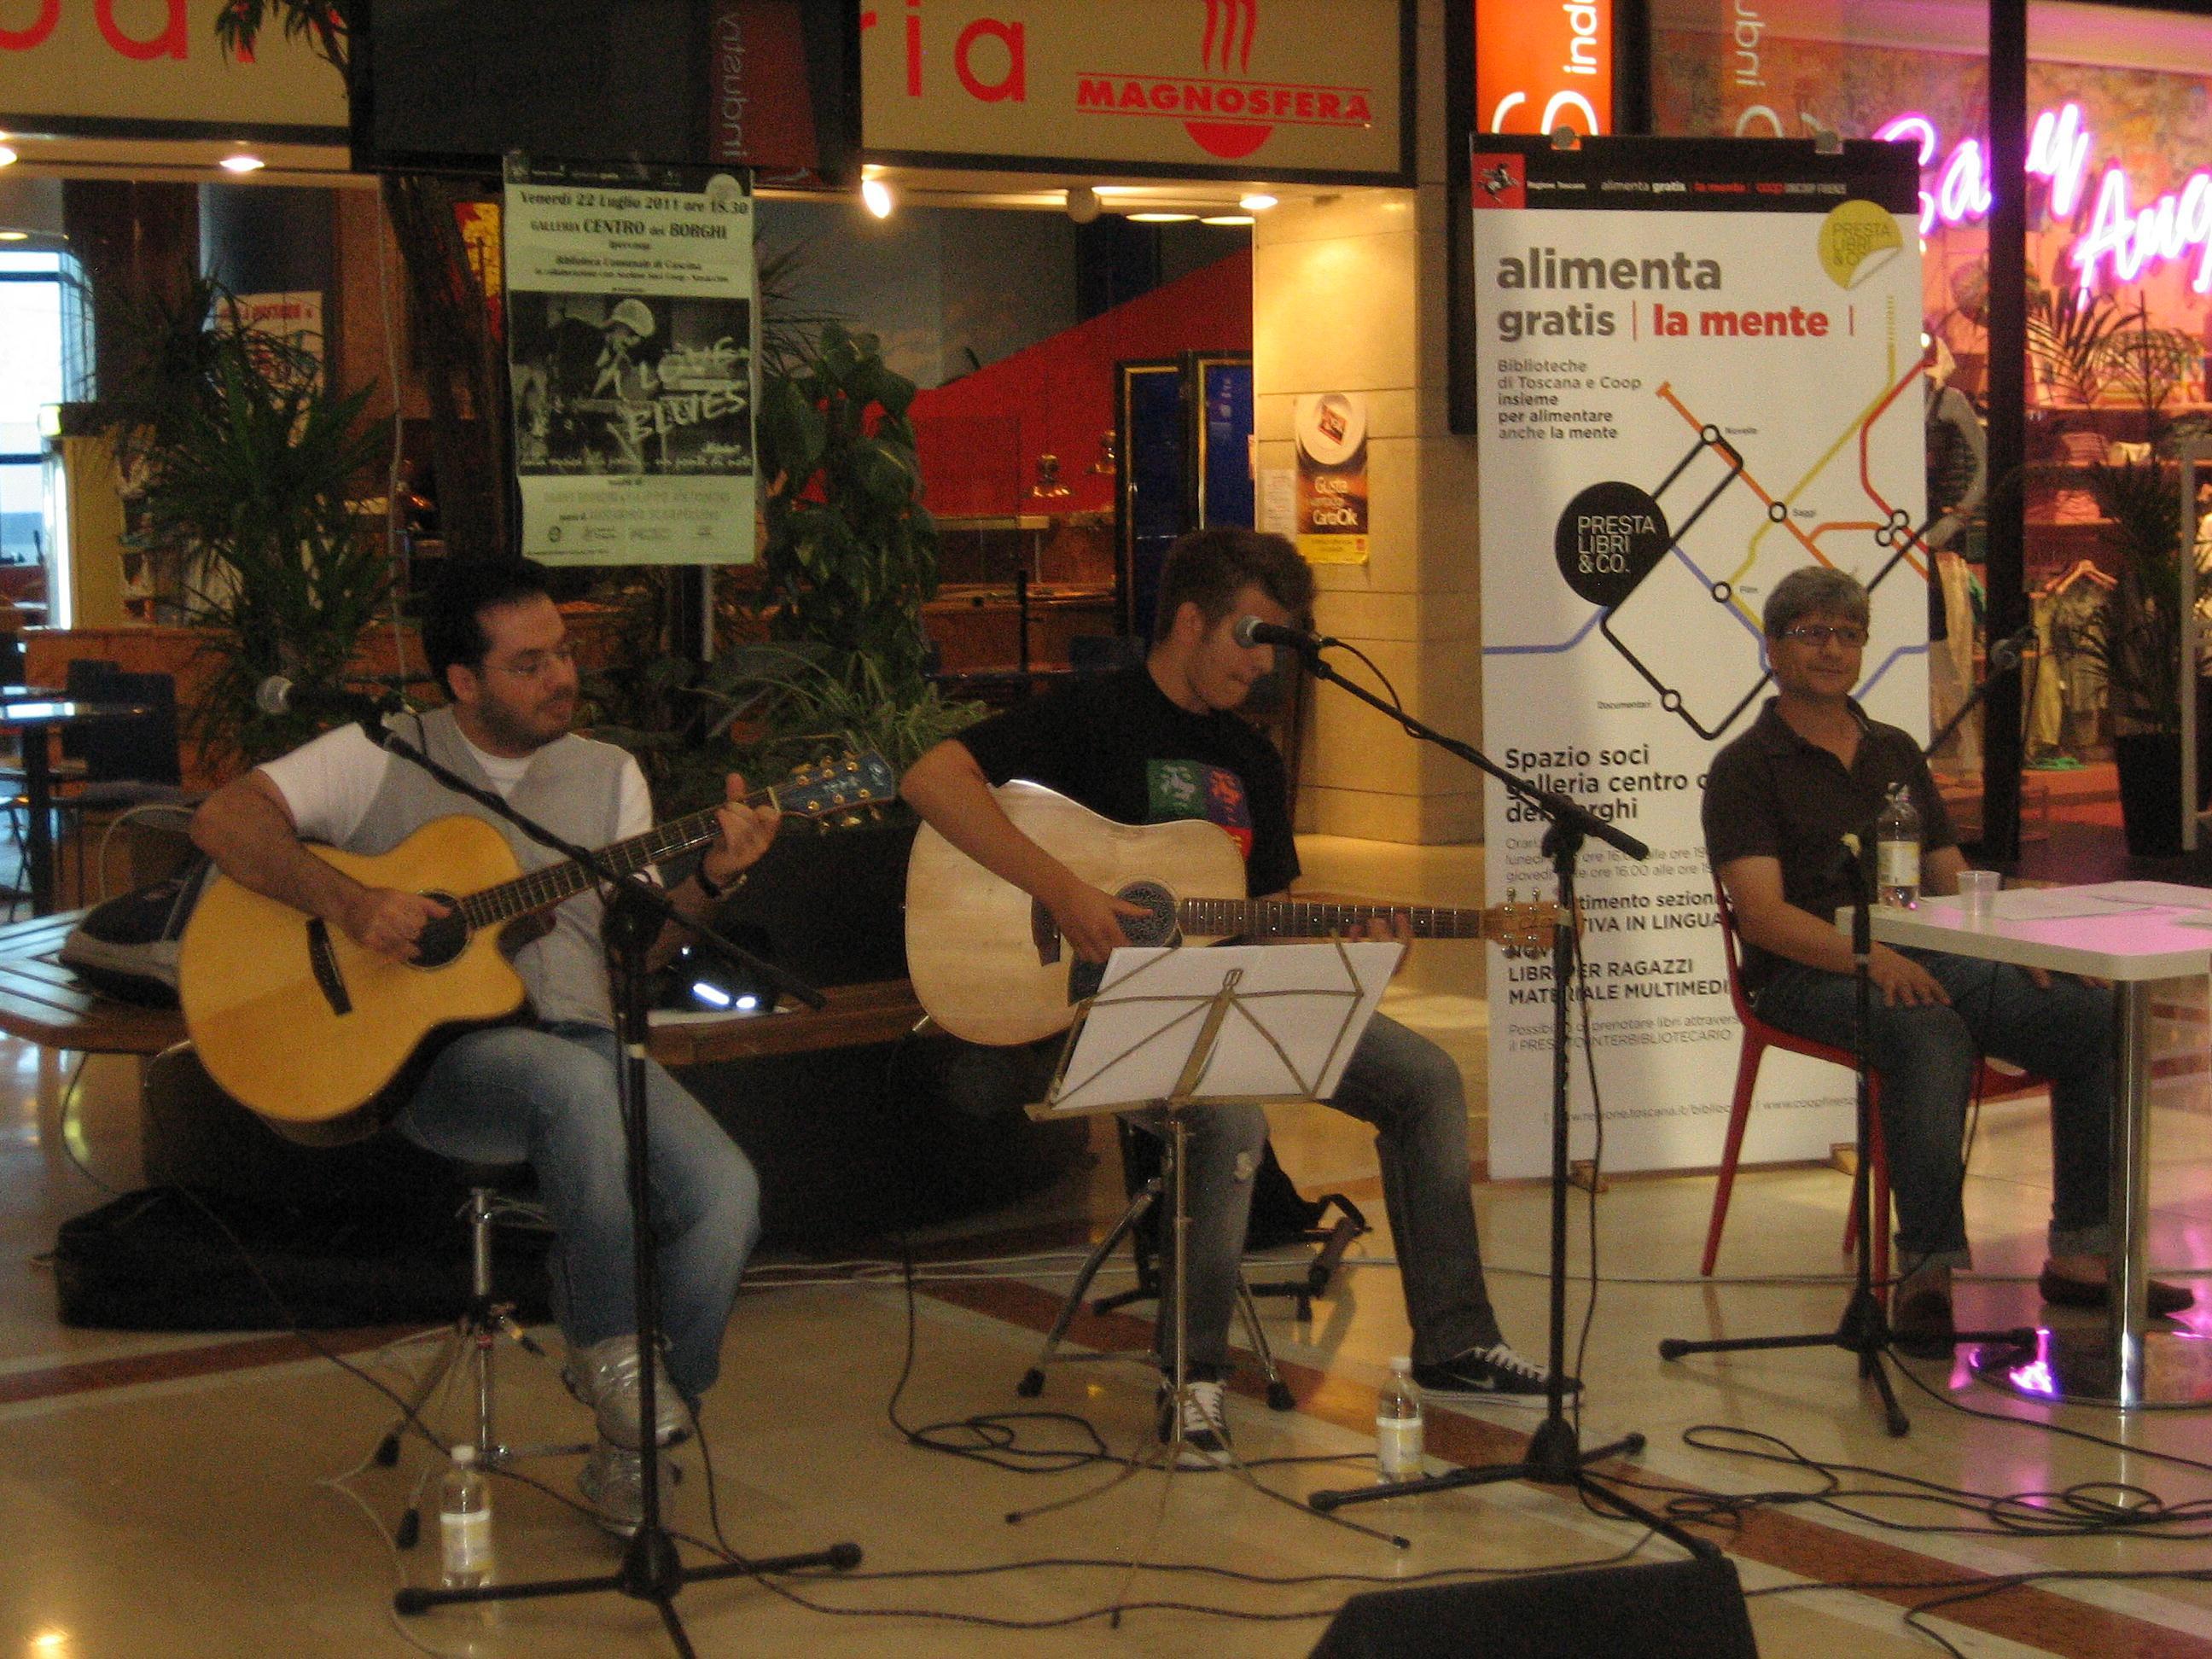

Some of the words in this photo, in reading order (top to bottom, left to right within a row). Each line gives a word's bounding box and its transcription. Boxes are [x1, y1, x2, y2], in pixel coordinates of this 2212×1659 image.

[1076, 79, 1372, 120] MAGNOSFERA
[519, 190, 571, 206] Venerdì
[575, 193, 596, 207] 22
[599, 195, 640, 211] Luglio
[644, 198, 679, 211] 2011
[684, 202, 704, 213] ore
[583, 218, 645, 236] CENTRO
[669, 223, 727, 240] BORGHI
[1497, 247, 1721, 290] alimenta
[1498, 302, 1615, 342] gratis
[1653, 304, 1688, 336] la
[1700, 306, 1829, 336] mente
[1498, 358, 1587, 373] Biblioteche
[1498, 375, 1516, 389] di
[1518, 376, 1582, 389] Toscana
[1586, 381, 1594, 389] e
[1600, 376, 1641, 392] Coop
[1498, 393, 1558, 406] insieme
[1498, 411, 1524, 424] per
[1529, 410, 1613, 423] alimentare
[1499, 425, 1545, 439] anche
[1550, 425, 1563, 439] la
[1569, 427, 1617, 439] mente
[1577, 515, 1656, 535] PRESTA
[1578, 534, 1632, 555] LIBRI
[1505, 745, 1591, 772] Spazio
[1599, 743, 1650, 766] soci
[1608, 771, 1688, 792] centro
[1656, 890, 1719, 906] sezion
[1626, 915, 1645, 932] IN
[1652, 912, 1723, 930] LINGUA
[1509, 965, 1554, 983] LIBR
[1607, 958, 1694, 977] RAGAZZI
[1590, 1028, 1732, 1047] NTERBIBLIOTECARIO
